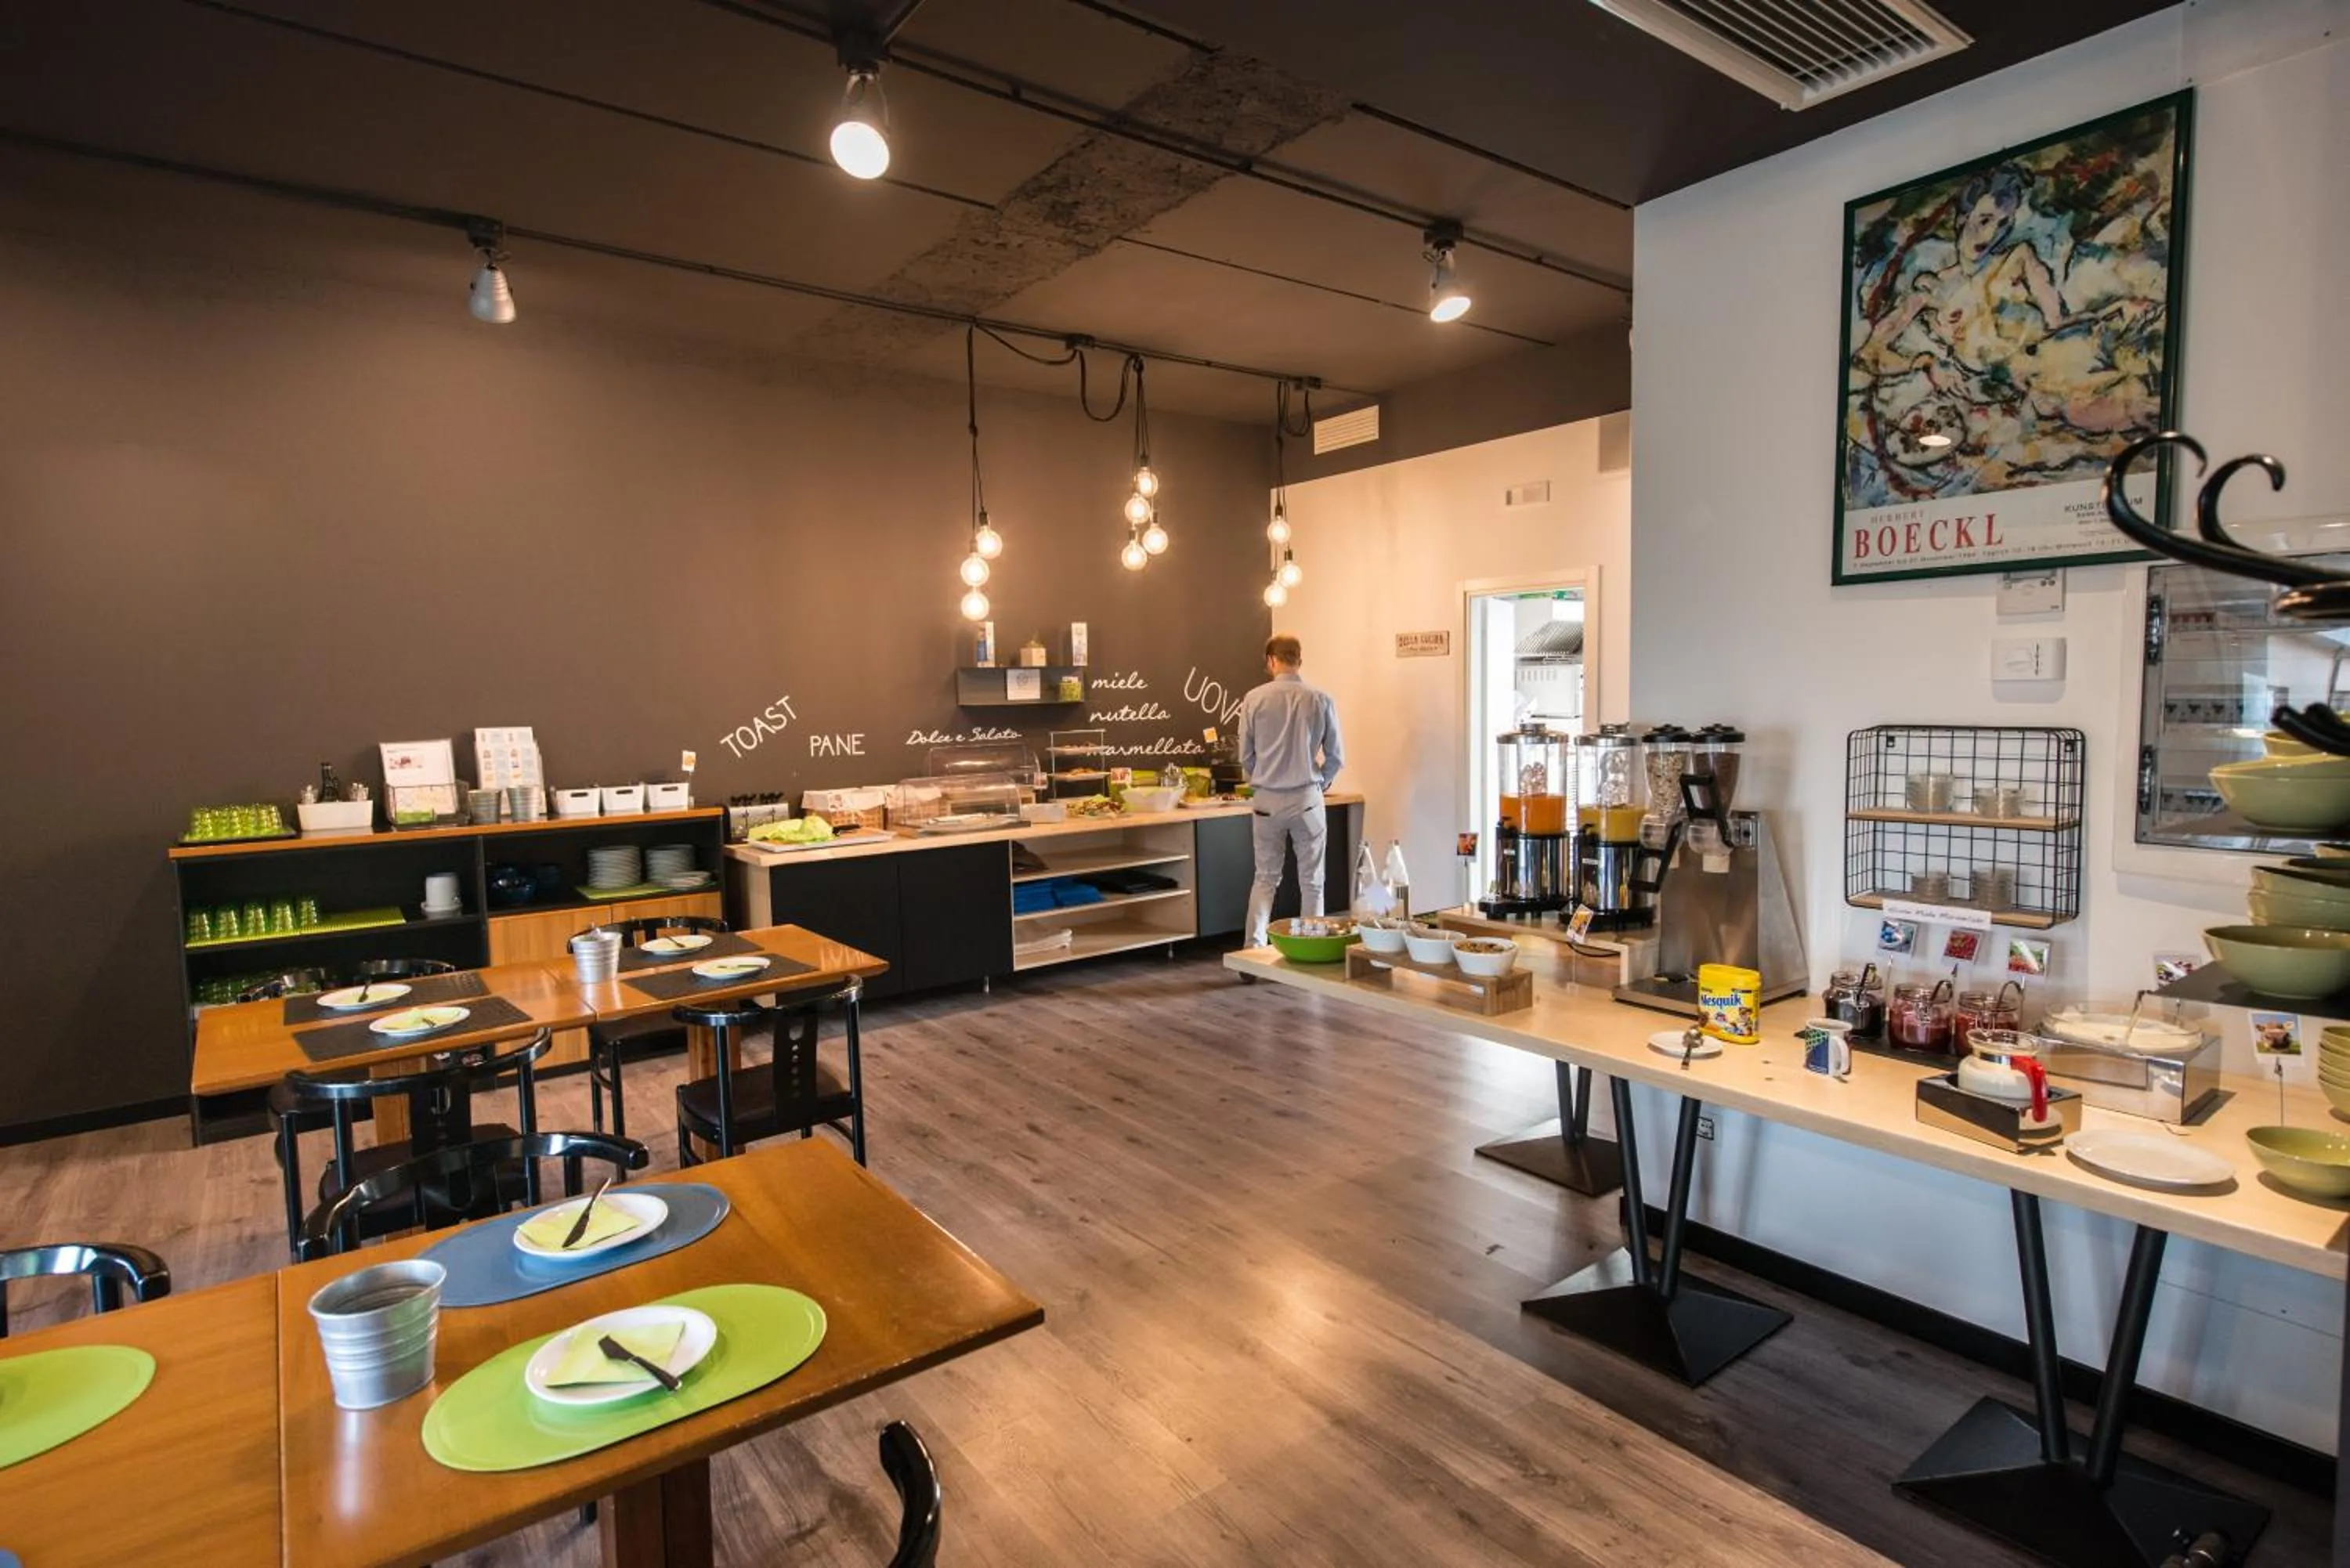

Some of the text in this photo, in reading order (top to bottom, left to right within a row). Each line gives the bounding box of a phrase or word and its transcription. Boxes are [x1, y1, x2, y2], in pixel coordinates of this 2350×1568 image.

[1854, 513, 2004, 558] BOECKL
[1091, 671, 1149, 689] miele
[1090, 703, 1171, 723] nutella
[719, 695, 797, 758] TOAST
[906, 729, 953, 745] Dolce
[968, 726, 1023, 742] Salato
[810, 733, 866, 757] PANE
[1701, 994, 1742, 1009] Nesquik
